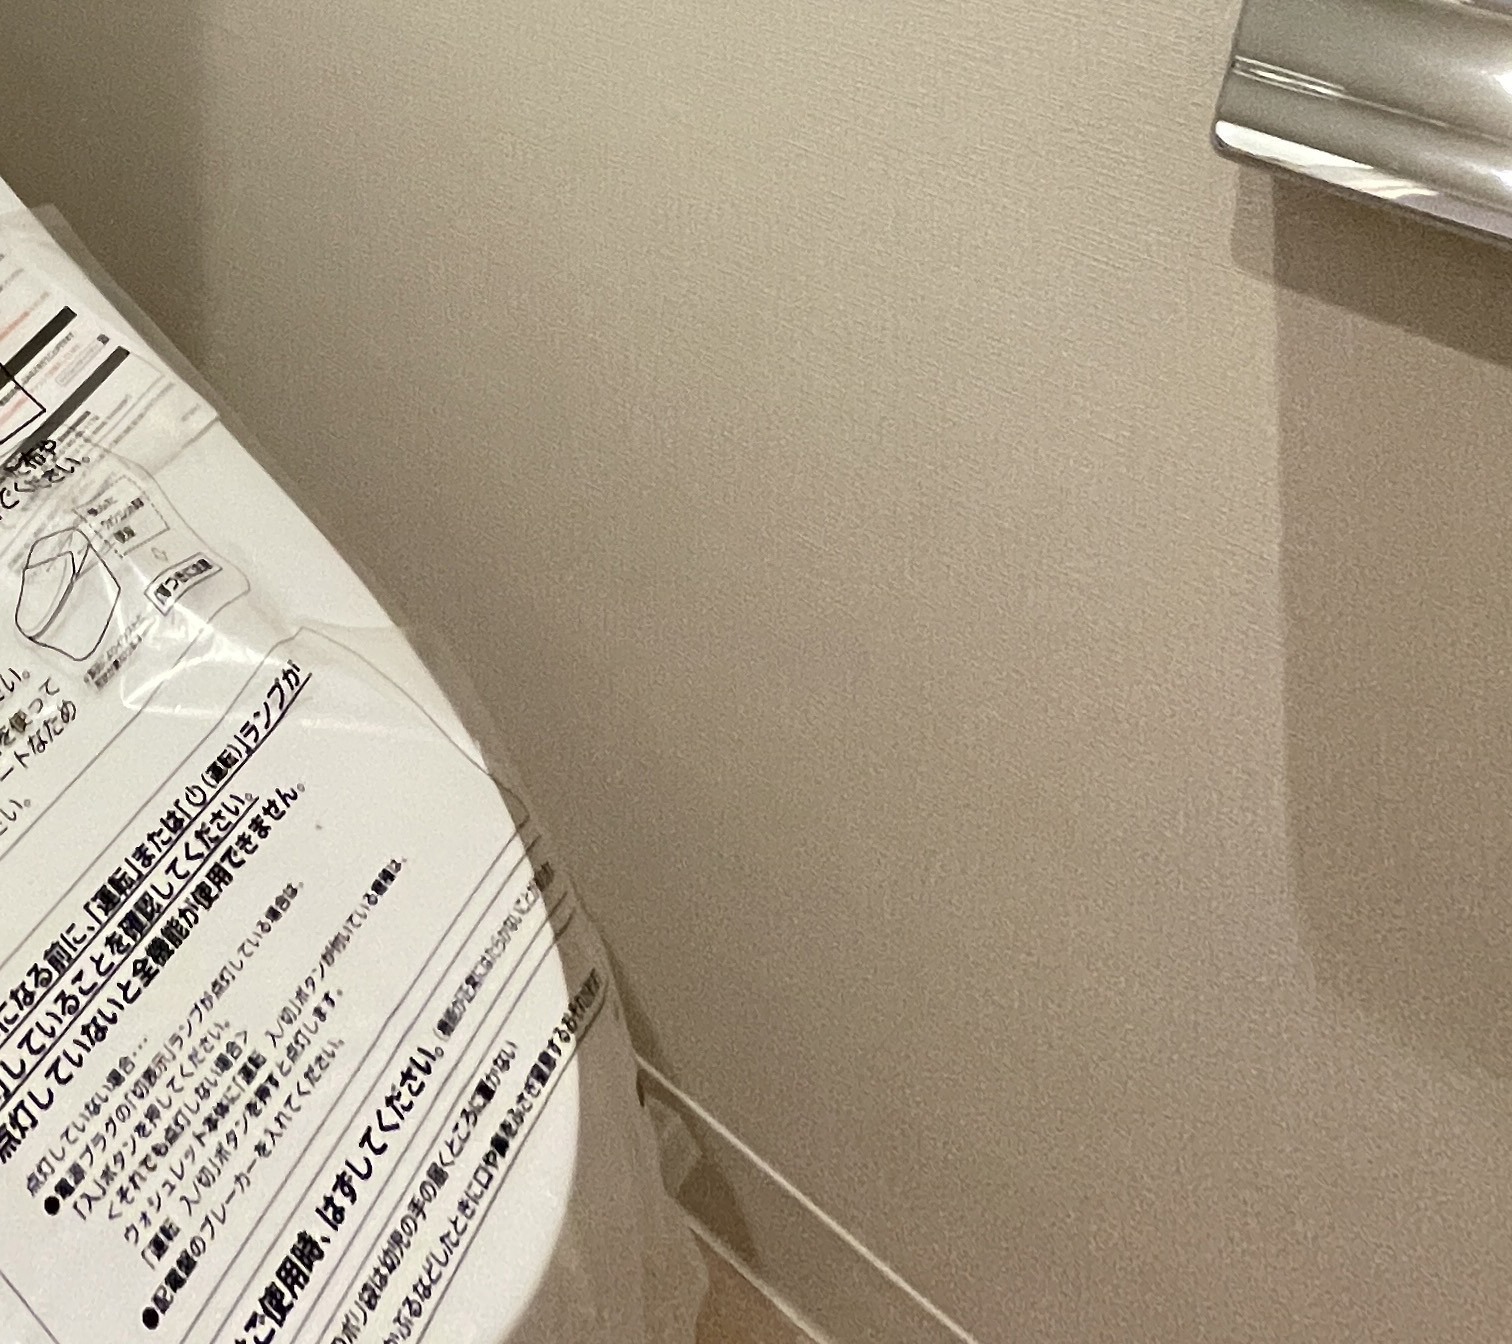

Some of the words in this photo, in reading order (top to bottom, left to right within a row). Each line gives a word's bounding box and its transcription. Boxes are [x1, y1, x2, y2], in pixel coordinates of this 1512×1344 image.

[235, 1047, 444, 1344] ご使用時、はずしてください。
